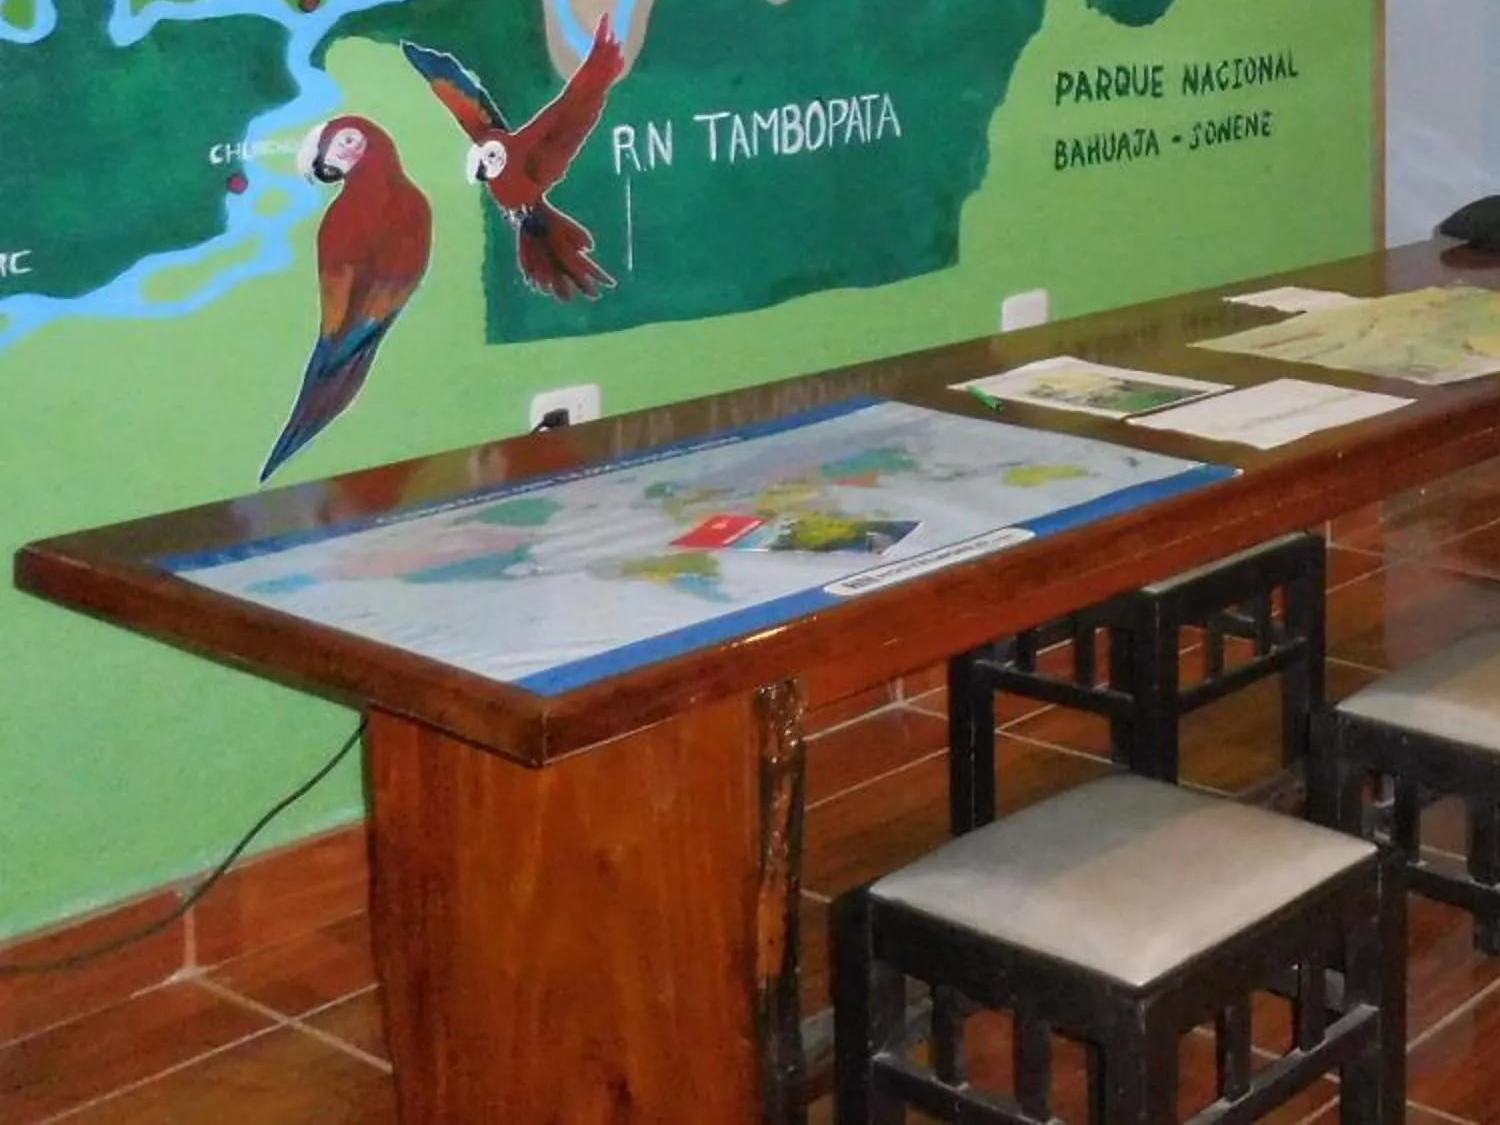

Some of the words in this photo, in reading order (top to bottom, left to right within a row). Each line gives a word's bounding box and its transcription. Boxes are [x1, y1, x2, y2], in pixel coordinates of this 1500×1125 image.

[1055, 65, 1165, 107] PARQUE
[1182, 50, 1300, 96] NACIONAL
[693, 92, 902, 163] TAMBOPATA
[1053, 129, 1160, 172] BAHUAJA
